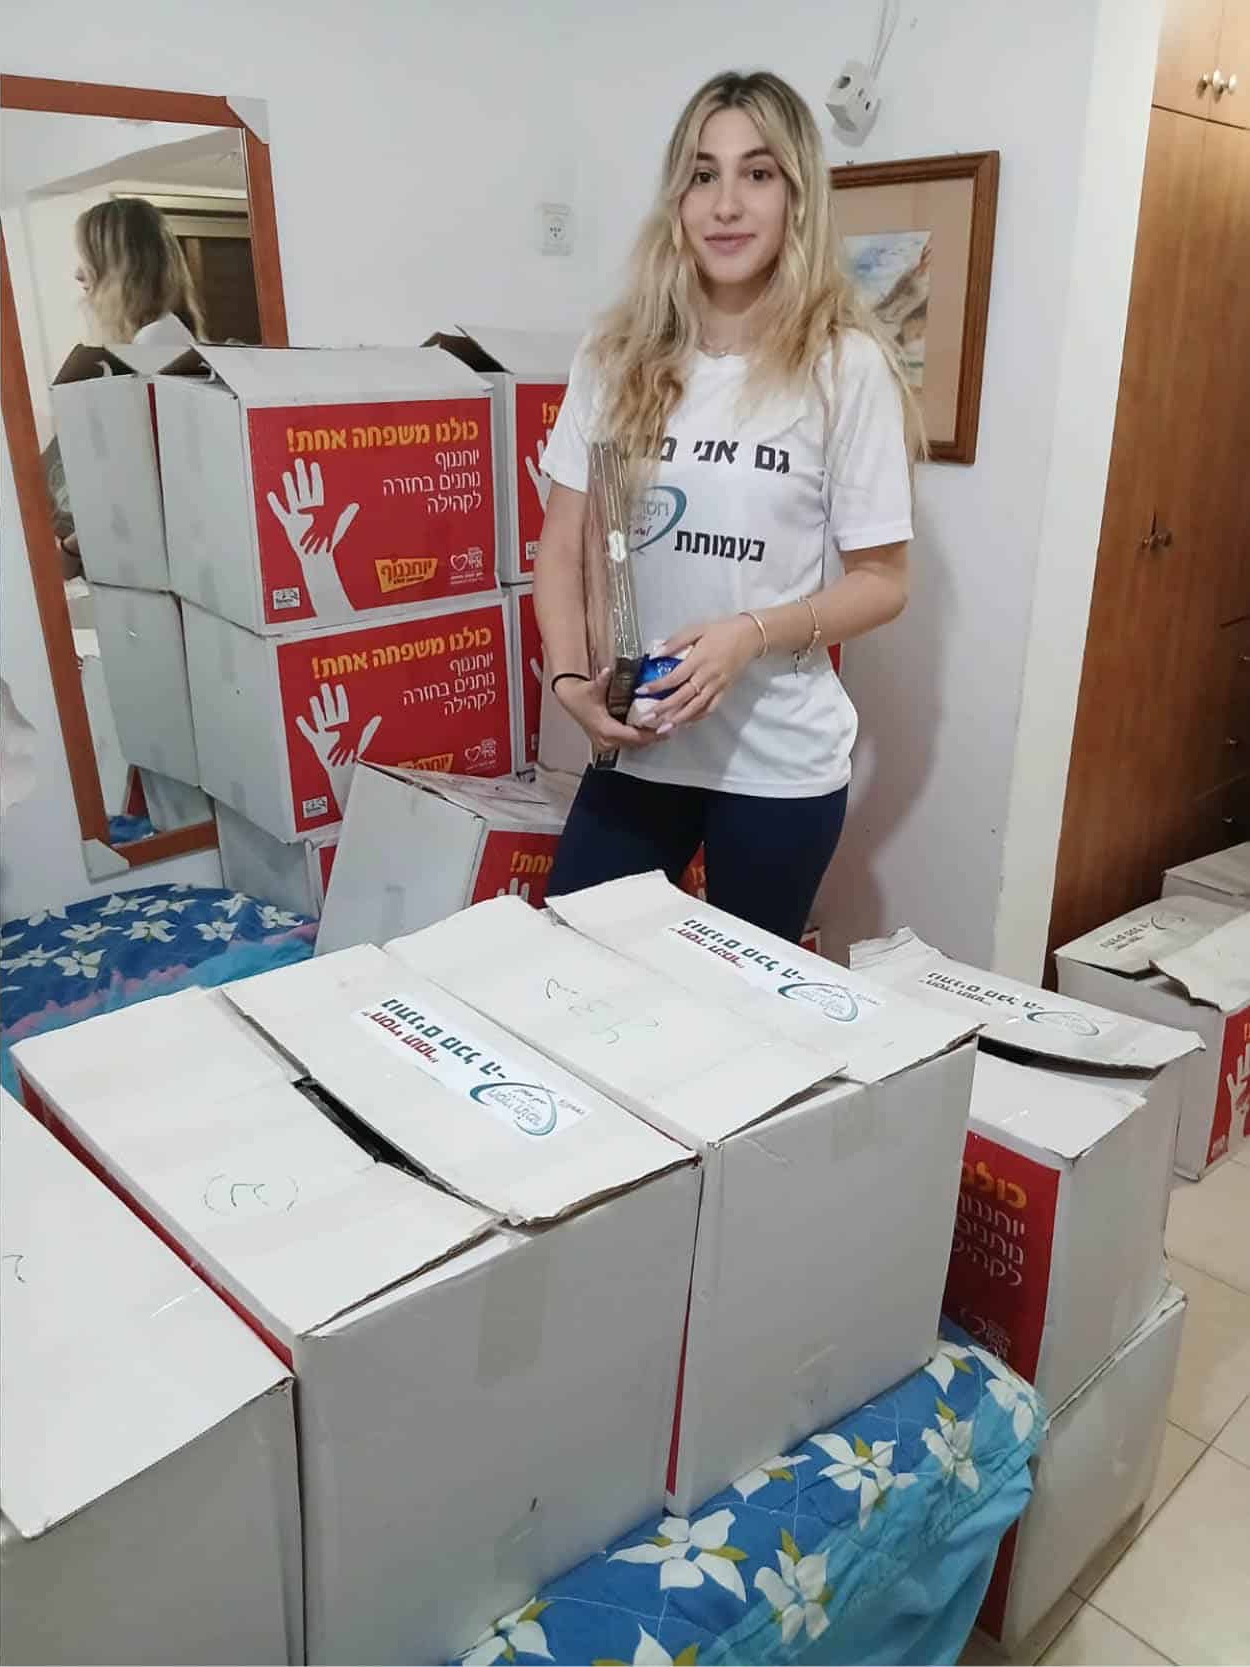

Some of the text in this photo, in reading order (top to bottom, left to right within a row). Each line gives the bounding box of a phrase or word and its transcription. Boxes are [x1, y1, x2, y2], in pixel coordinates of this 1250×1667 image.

[286, 416, 479, 453] כולנו משפחה אחת!
[434, 449, 481, 472] יוחננוף
[693, 440, 739, 464] אני
[755, 444, 790, 474] גם
[383, 470, 482, 497] נותנים בחזרה
[427, 493, 482, 514] לקהילה
[675, 529, 765, 562] בעמותת
[312, 627, 492, 679] כולנו משפחה אחת!
[450, 653, 494, 675] יוחננוף
[403, 674, 495, 705] נותנים בחזרה
[444, 689, 496, 716] לקהילה
[684, 919, 740, 949] נותנים
[741, 948, 780, 972] מכל
[381, 999, 444, 1038] נותנים
[438, 1037, 482, 1065] מכל
